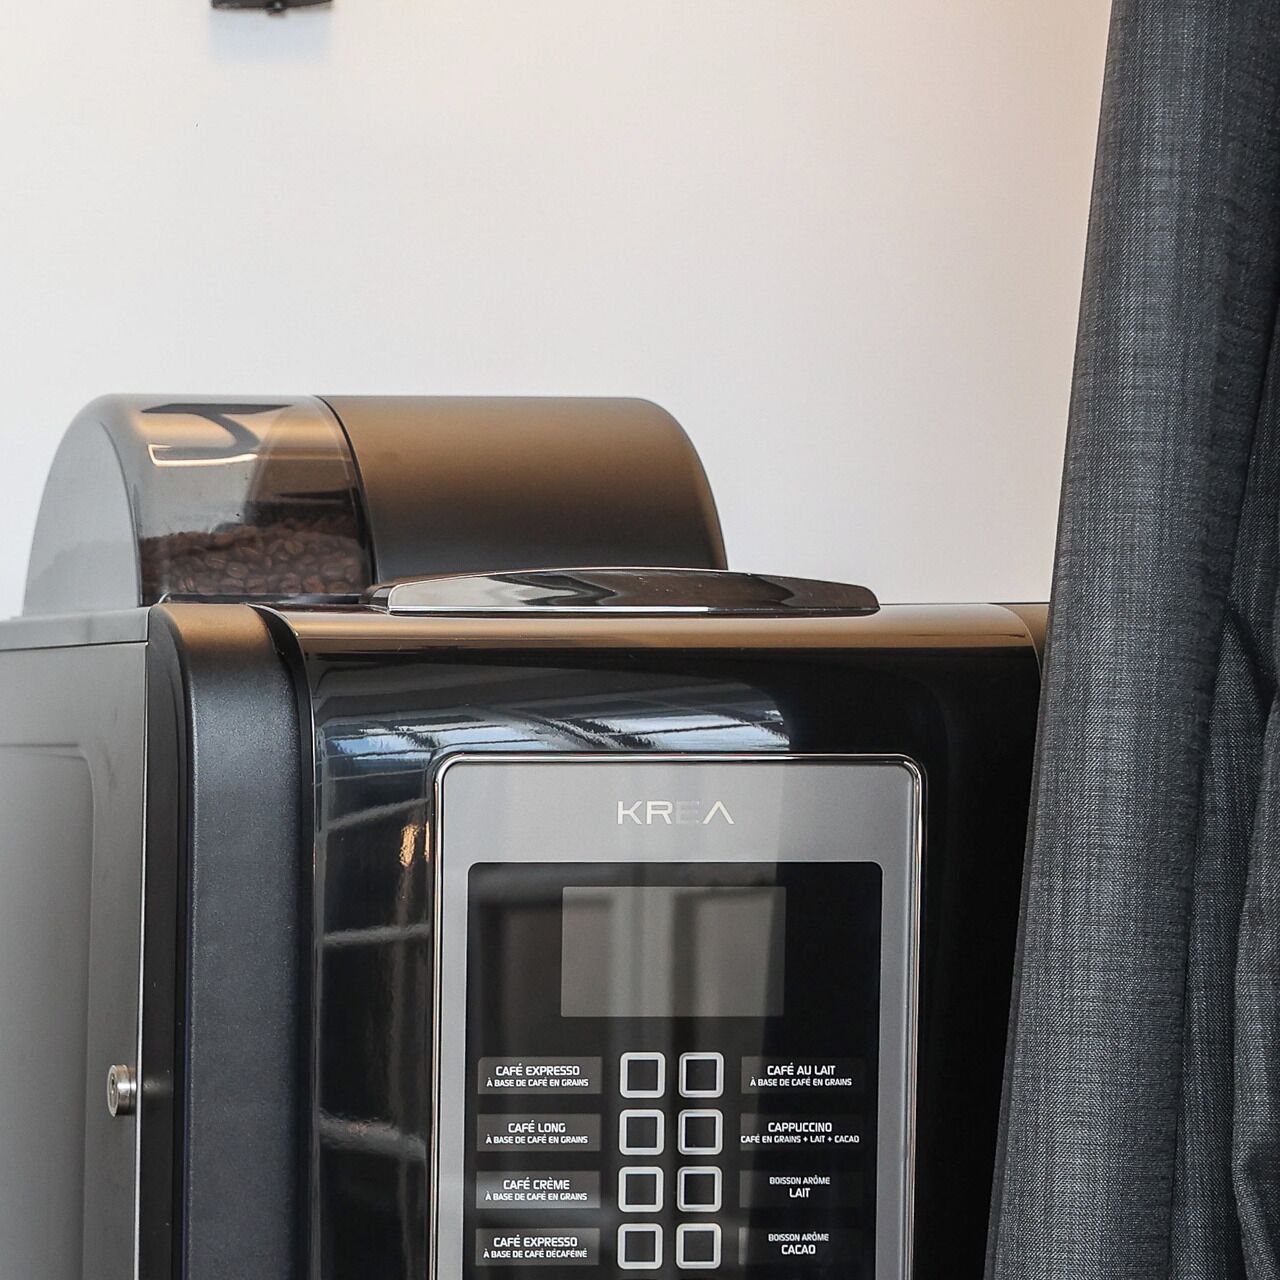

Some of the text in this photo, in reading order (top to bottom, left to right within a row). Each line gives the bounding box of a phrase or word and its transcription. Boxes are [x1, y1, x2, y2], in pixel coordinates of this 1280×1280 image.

[617, 800, 736, 825] KREA
[496, 1063, 580, 1076] CAFÉ EXPRESSO
[767, 1062, 836, 1075] CAFÉ AU LAIT
[494, 1079, 514, 1087] BASE
[516, 1079, 526, 1087] DE
[528, 1077, 547, 1087] CAFÉ
[550, 1079, 559, 1087] EN
[561, 1078, 589, 1087] GRAINS
[758, 1078, 777, 1086] BASE
[780, 1078, 789, 1086] DE
[791, 1077, 810, 1086] CAFÉ
[813, 1078, 823, 1086] EN
[825, 1078, 852, 1086] GRAINS
[508, 1120, 566, 1133] CAFÉ LONG
[768, 1122, 832, 1132] CAPPUCCINO
[494, 1136, 513, 1144] BASE
[515, 1136, 526, 1144] DE
[527, 1134, 546, 1144] CAFÉ
[549, 1136, 559, 1144] EN
[560, 1136, 588, 1144] GRAINS
[740, 1134, 760, 1143] CAFÉ
[774, 1135, 801, 1143] GRAINS
[810, 1135, 825, 1143] LAIT
[834, 1135, 860, 1143] CACAO
[503, 1177, 570, 1190] CAFÉ CRÈME
[769, 1175, 830, 1185] BOISSON ARÔME
[527, 1191, 546, 1200] CAFÉ
[560, 1192, 587, 1200] GRAINS
[789, 1188, 810, 1198] LAIT
[494, 1234, 578, 1247] CAFÉ EXPRESSO
[768, 1231, 829, 1242] BOISSON ARÔME
[491, 1250, 511, 1258] BASE
[513, 1250, 523, 1258] DE
[524, 1248, 544, 1258] CAFÉ
[546, 1248, 587, 1258] DÉCAFÉINÉ
[781, 1244, 816, 1255] CACAO
